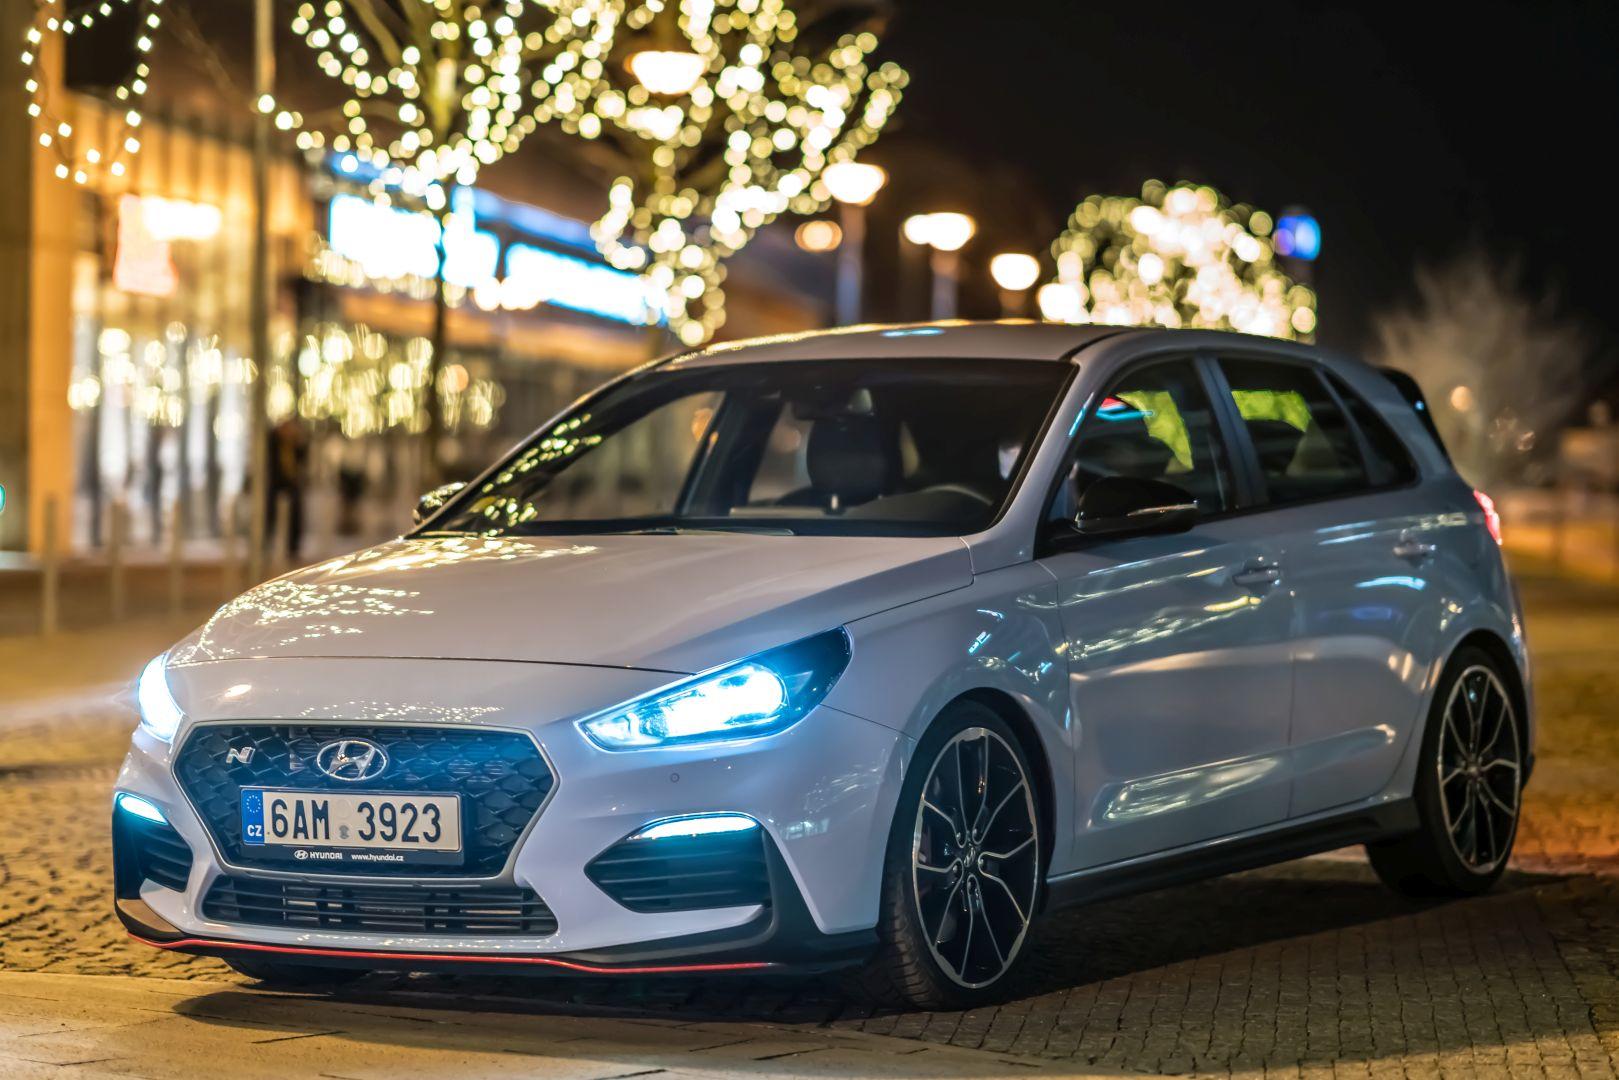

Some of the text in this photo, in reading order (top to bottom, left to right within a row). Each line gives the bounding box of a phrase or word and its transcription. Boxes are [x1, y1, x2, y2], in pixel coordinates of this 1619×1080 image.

[271, 799, 441, 843] 6AM 3923
[247, 825, 263, 837] CZ
[310, 852, 342, 860] HYUNDAI
[351, 853, 404, 862] www.hyundai.cz
